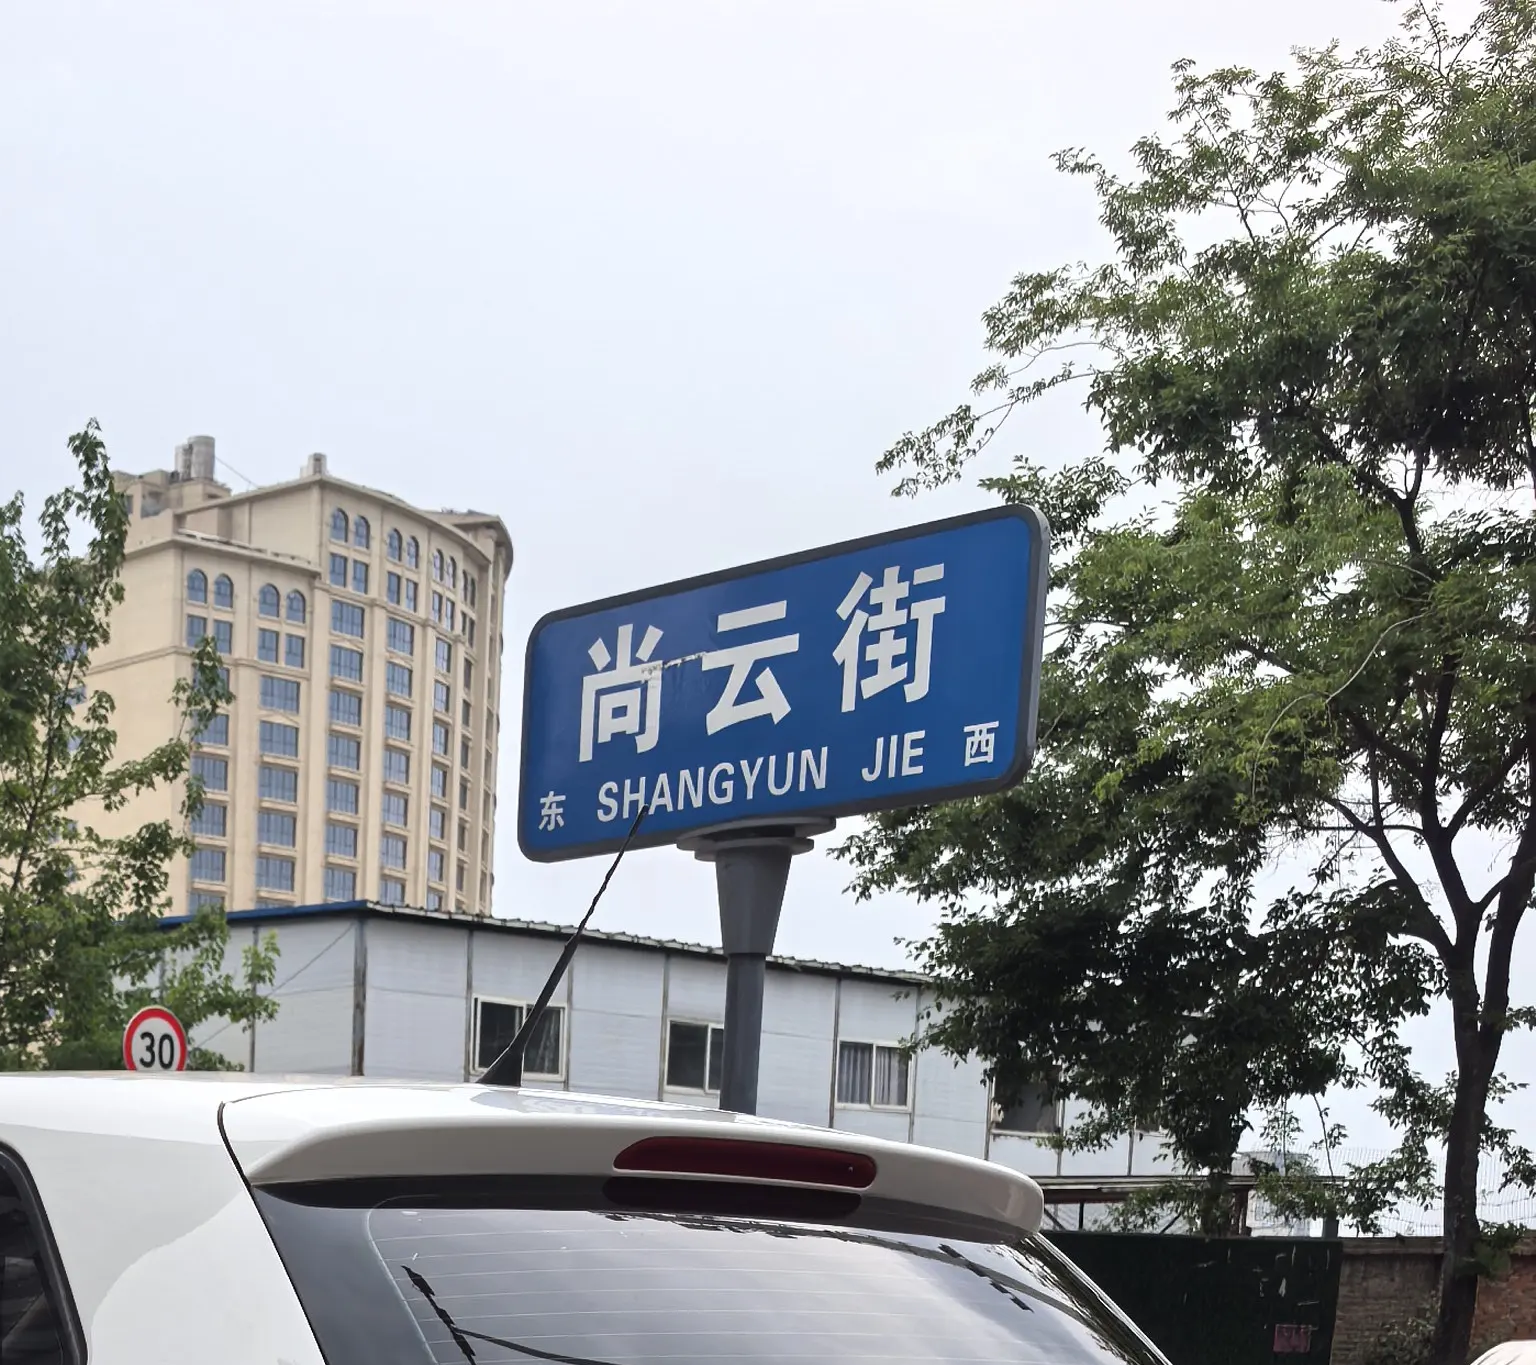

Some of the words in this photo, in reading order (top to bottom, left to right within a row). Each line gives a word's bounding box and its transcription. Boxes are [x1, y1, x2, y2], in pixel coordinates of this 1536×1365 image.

[578, 562, 947, 763] 尚云街
[963, 721, 1000, 767] 西
[595, 746, 829, 823] SHANGYUN
[861, 730, 927, 782] JIE
[538, 790, 566, 832] 东
[139, 1031, 175, 1070] 30
